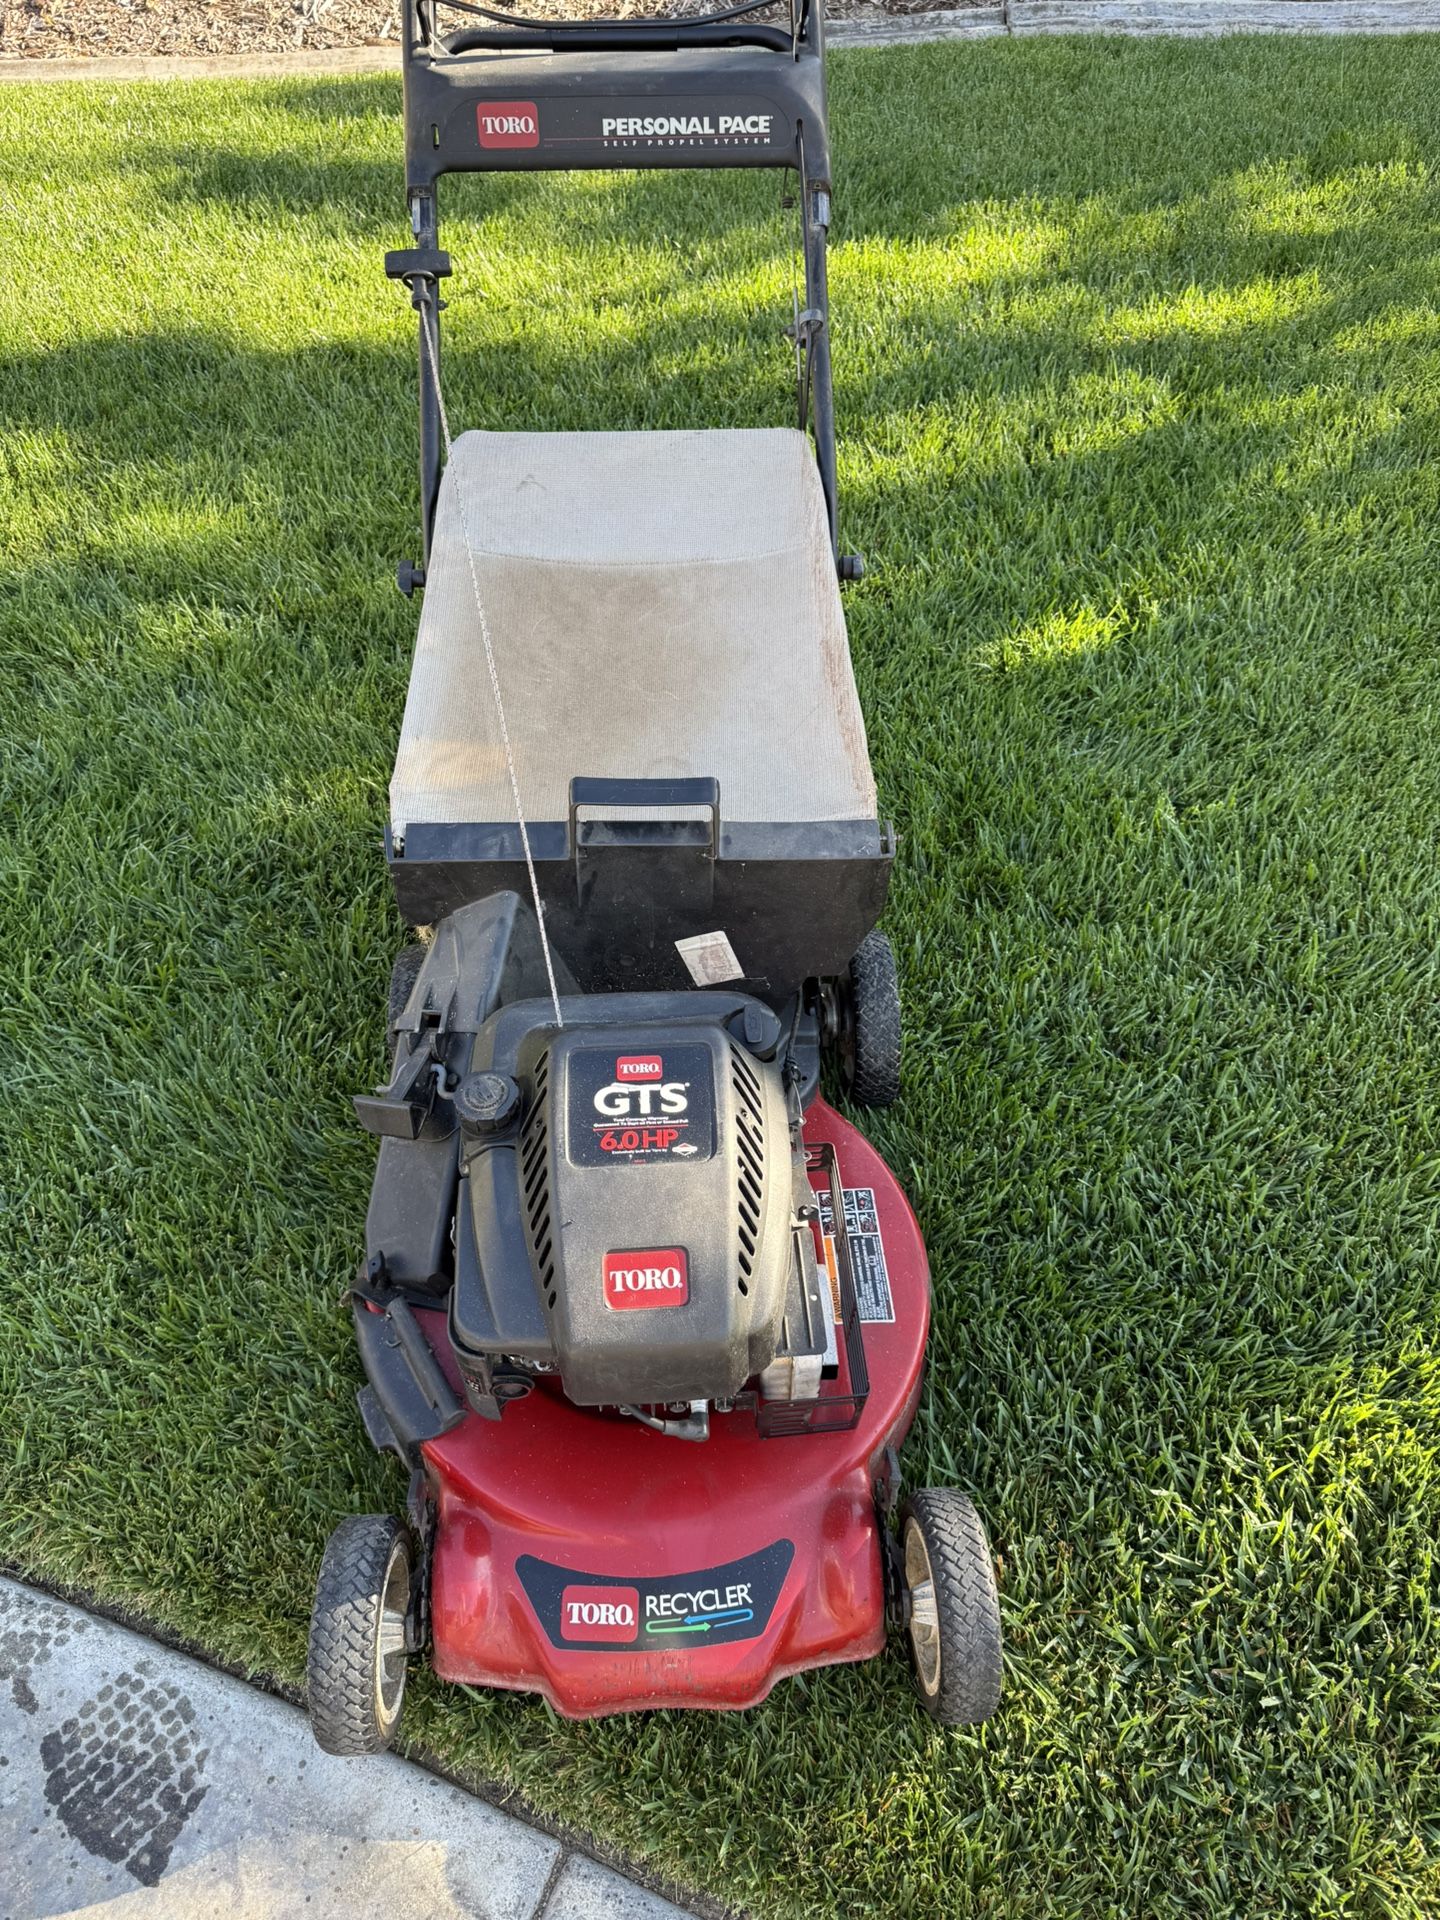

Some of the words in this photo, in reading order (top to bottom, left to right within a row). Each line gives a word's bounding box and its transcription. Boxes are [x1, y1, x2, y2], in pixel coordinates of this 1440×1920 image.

[482, 116, 535, 134] TORO
[602, 116, 715, 136] PERSONAL
[719, 115, 771, 134] PACE
[620, 1063, 660, 1074] TORO
[593, 1082, 689, 1115] GTS
[600, 1130, 640, 1151] 6.0
[642, 1128, 679, 1149] HP
[609, 1267, 681, 1292] TORO
[567, 1603, 634, 1625] TORO
[645, 1583, 754, 1617] RECYCLER
